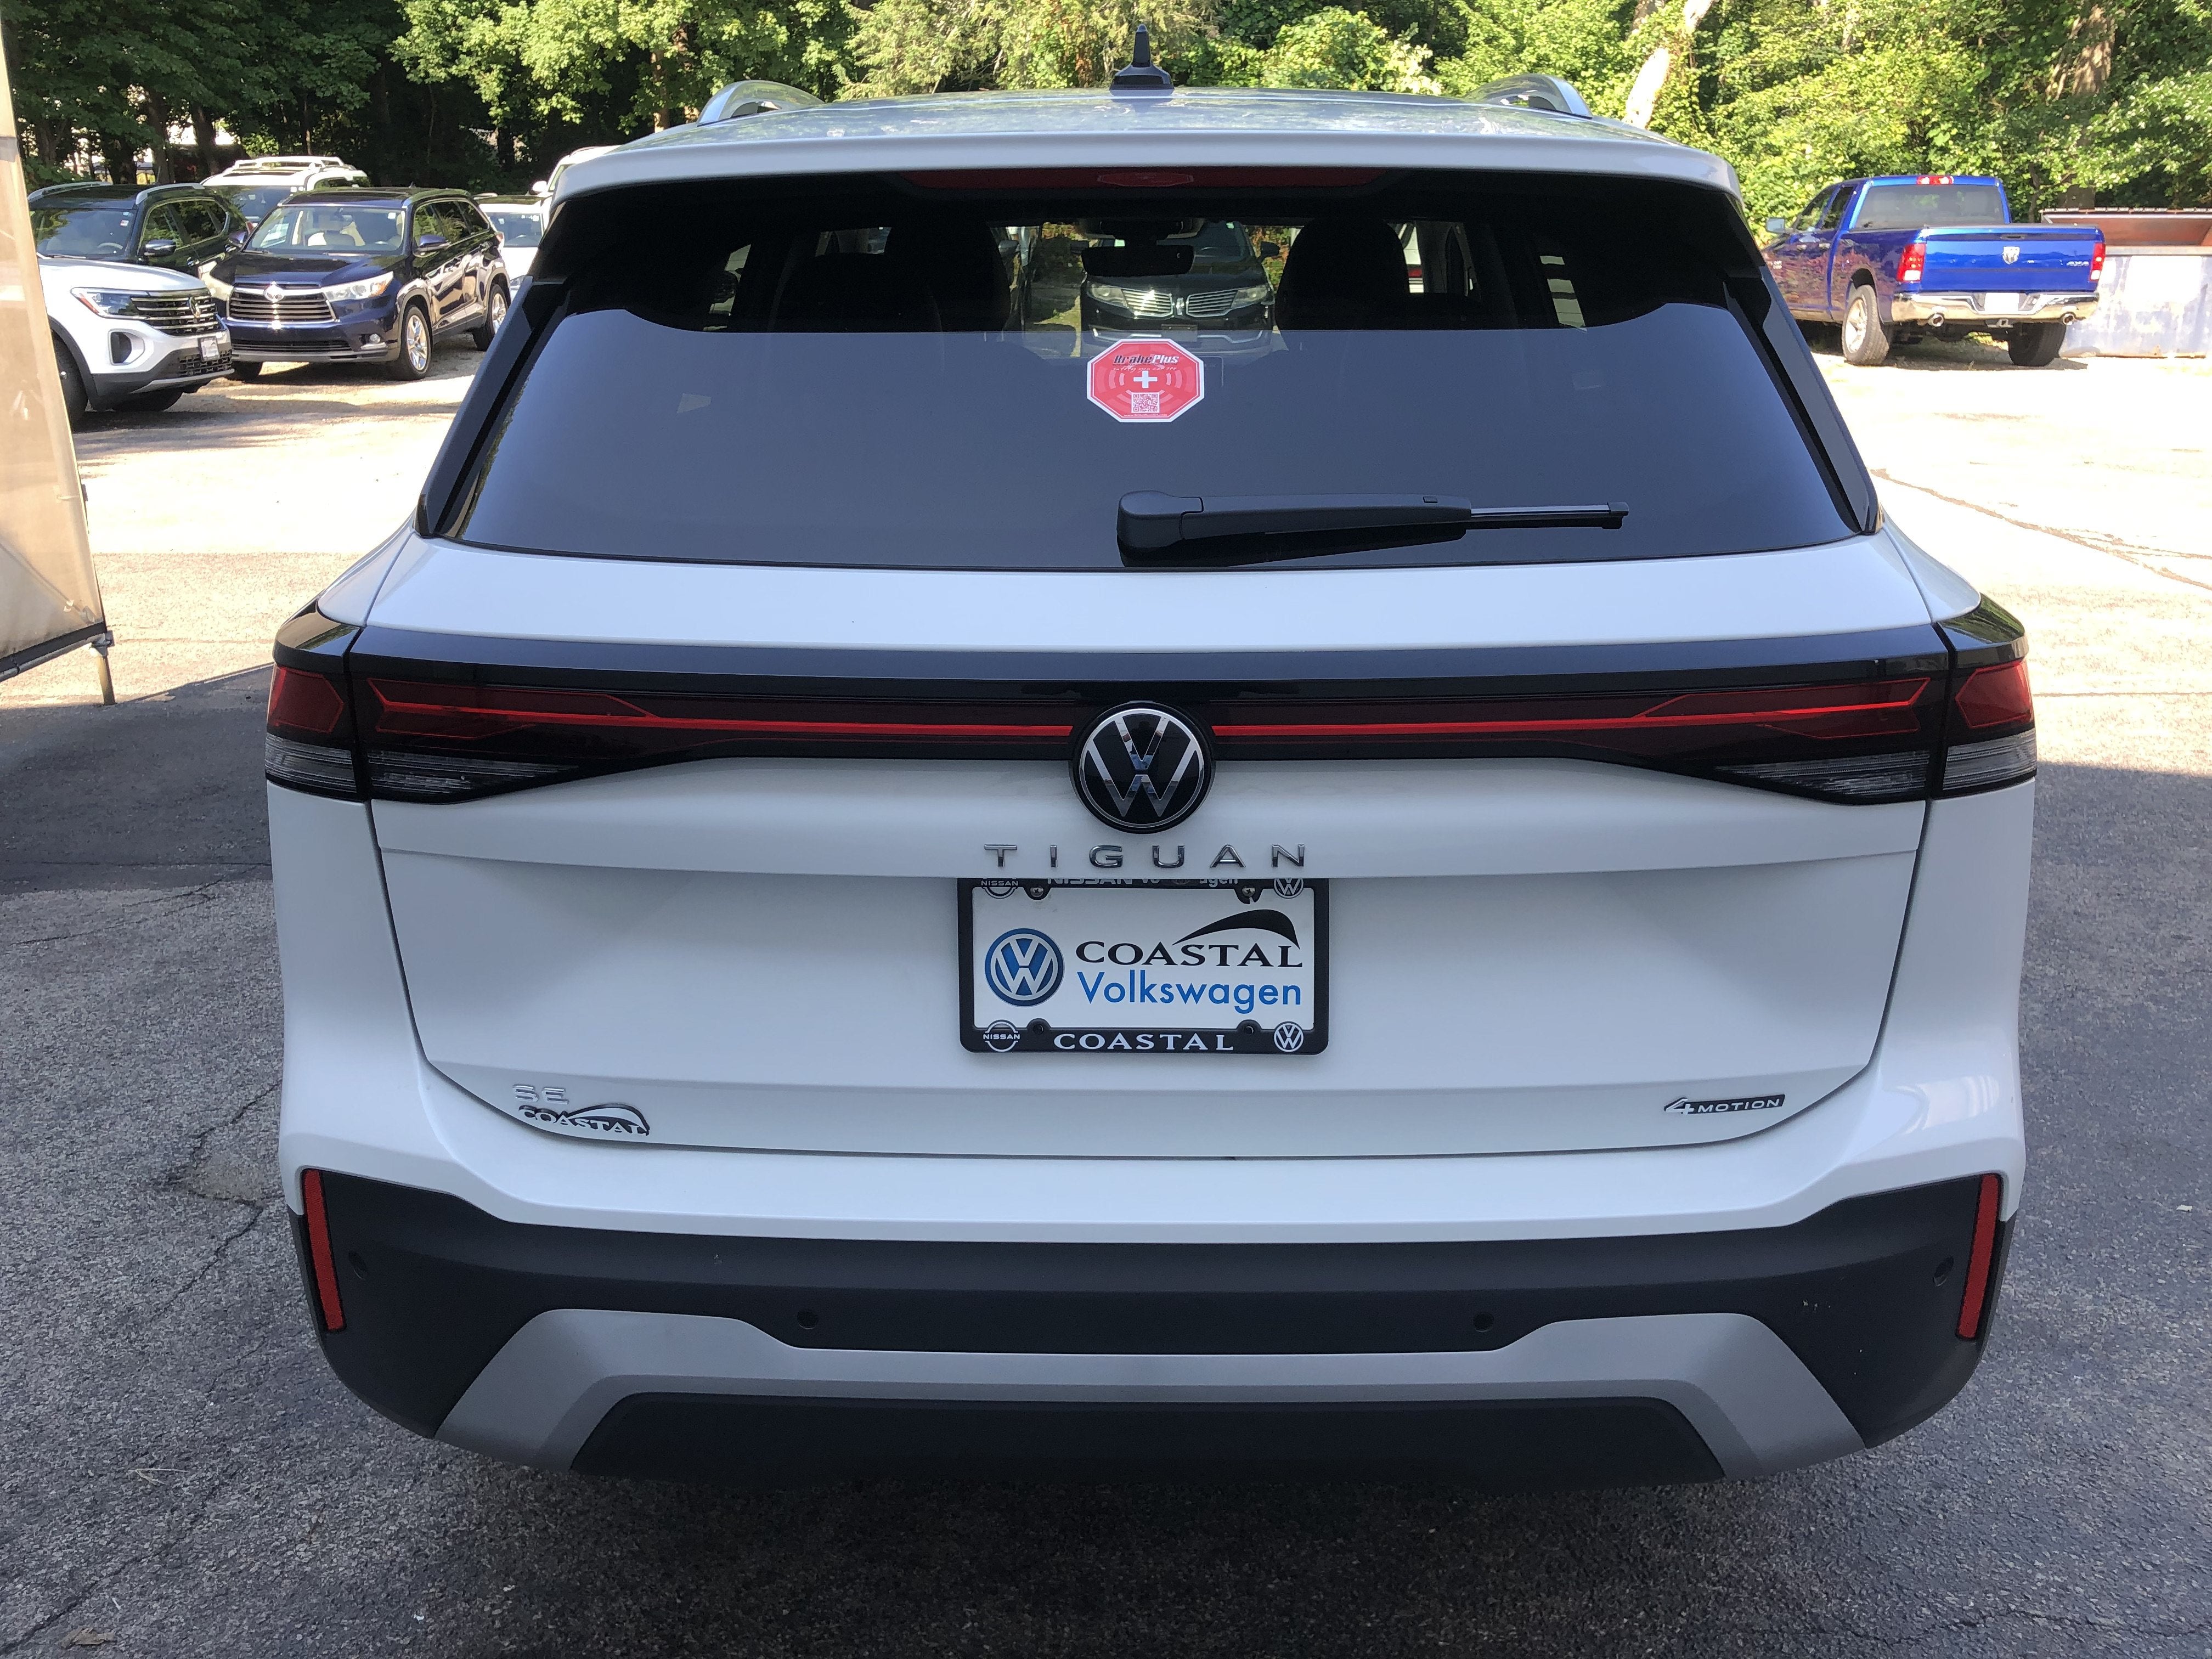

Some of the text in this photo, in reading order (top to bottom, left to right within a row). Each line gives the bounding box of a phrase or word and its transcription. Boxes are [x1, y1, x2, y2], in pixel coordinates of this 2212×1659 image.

[1113, 354, 1179, 364] BrakePlus
[984, 844, 1305, 868] TIGUAN
[1075, 940, 1303, 968] COASTAL
[1076, 969, 1301, 1014] Volkswagen
[1053, 1032, 1234, 1051] COASTAL
[512, 1084, 569, 1105] SE
[1664, 1097, 1780, 1115] 4MOTION
[518, 1105, 650, 1136] COASTAL
